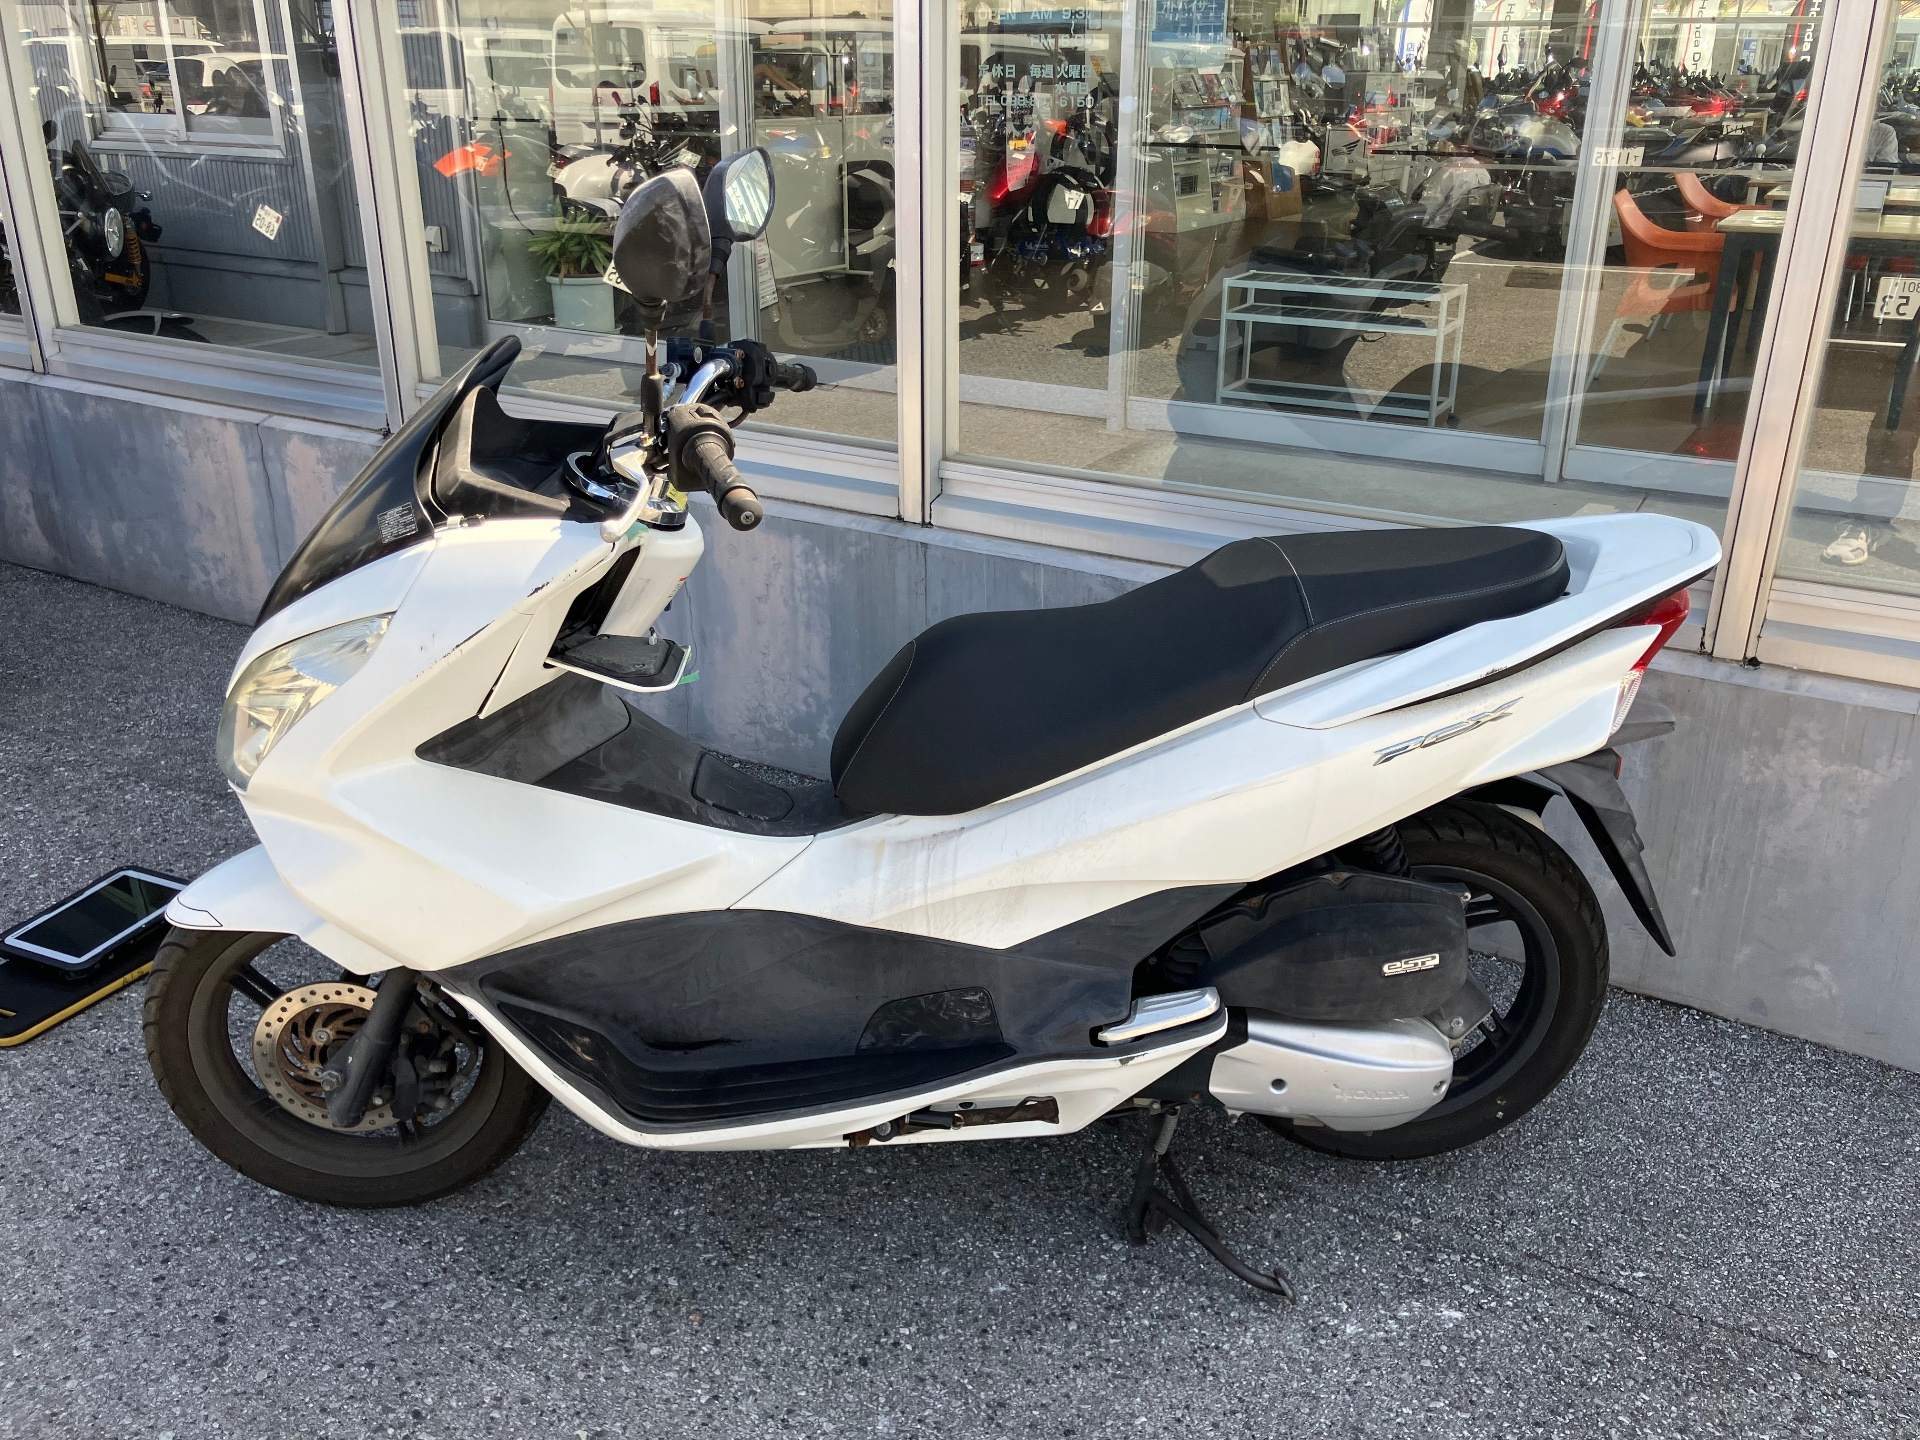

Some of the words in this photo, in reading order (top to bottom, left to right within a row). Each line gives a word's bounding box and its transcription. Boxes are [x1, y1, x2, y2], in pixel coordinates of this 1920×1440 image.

[977, 8, 1016, 20] OPEN
[1030, 8, 1053, 20] AM
[979, 64, 1016, 78] 定休日
[1030, 64, 1054, 78] 毎週
[1057, 64, 1092, 78] 火曜日
[1055, 82, 1089, 94] 水曜日
